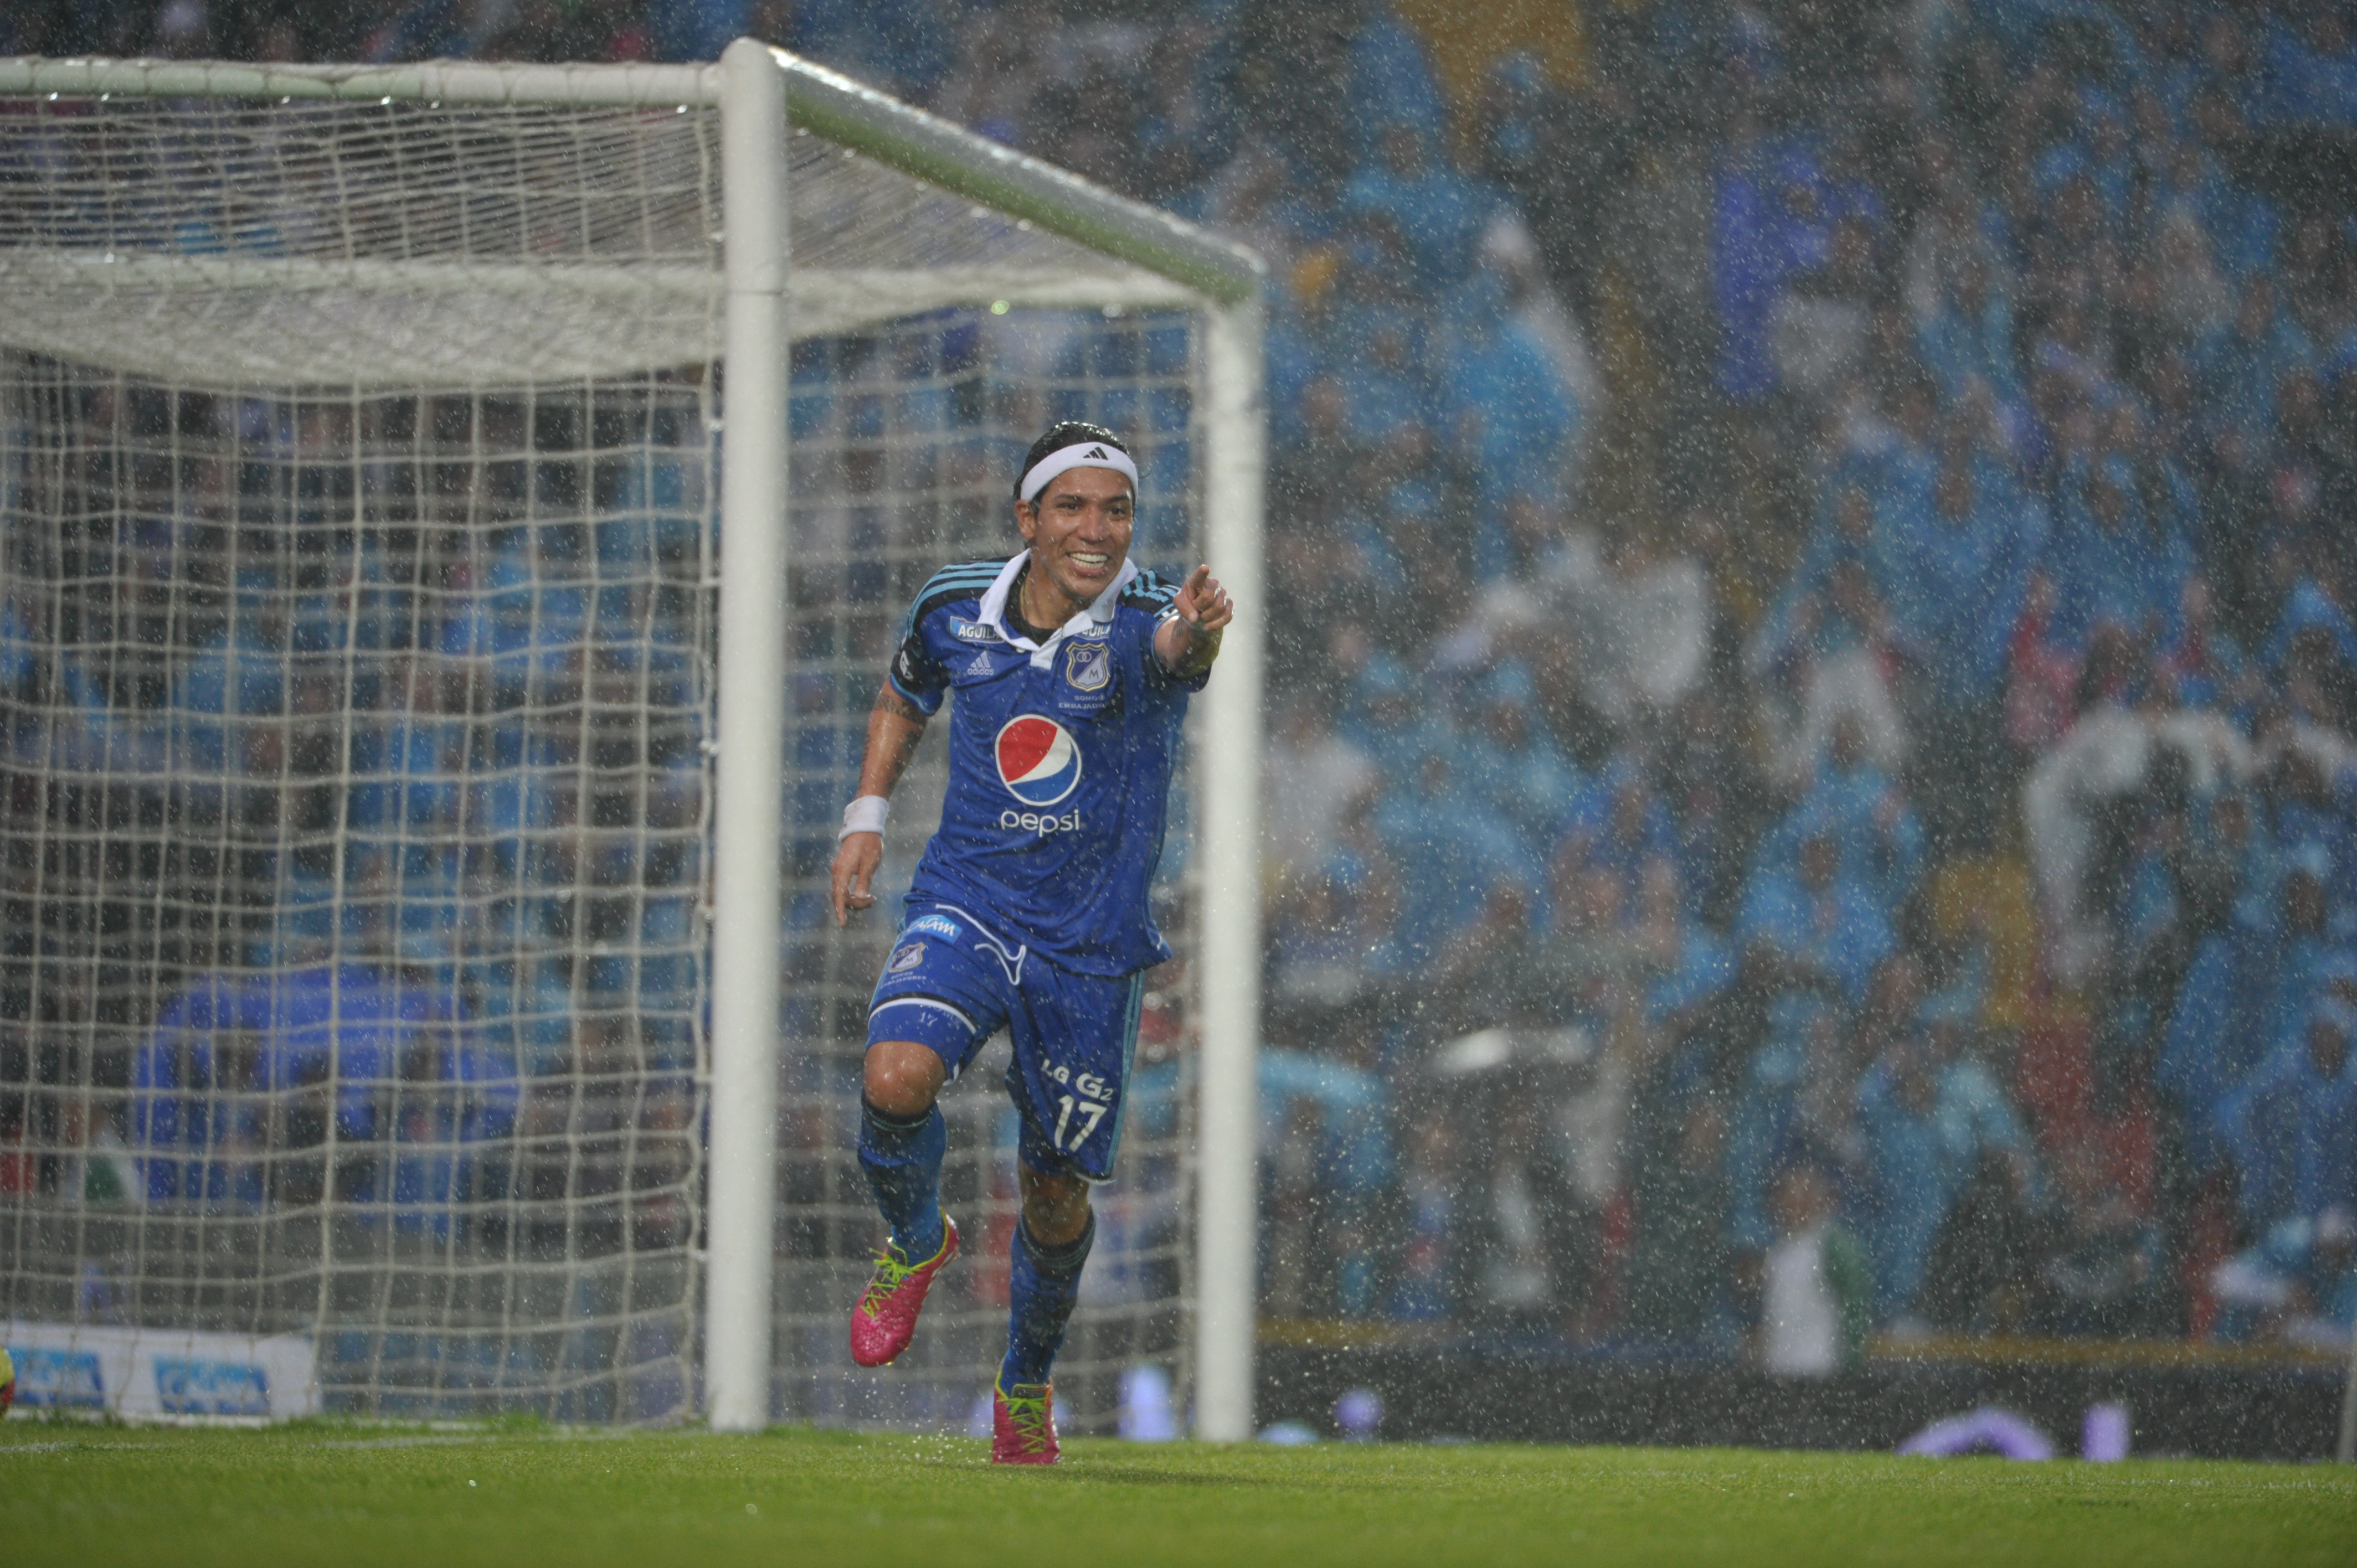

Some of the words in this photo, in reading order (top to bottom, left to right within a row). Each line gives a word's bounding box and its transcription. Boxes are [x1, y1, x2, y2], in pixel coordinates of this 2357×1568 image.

[967, 667, 994, 675] adidas
[1000, 809, 1079, 838] pepsi
[1041, 1058, 1069, 1085] LG
[1076, 1072, 1114, 1101] G2
[1054, 1094, 1107, 1153] 17
